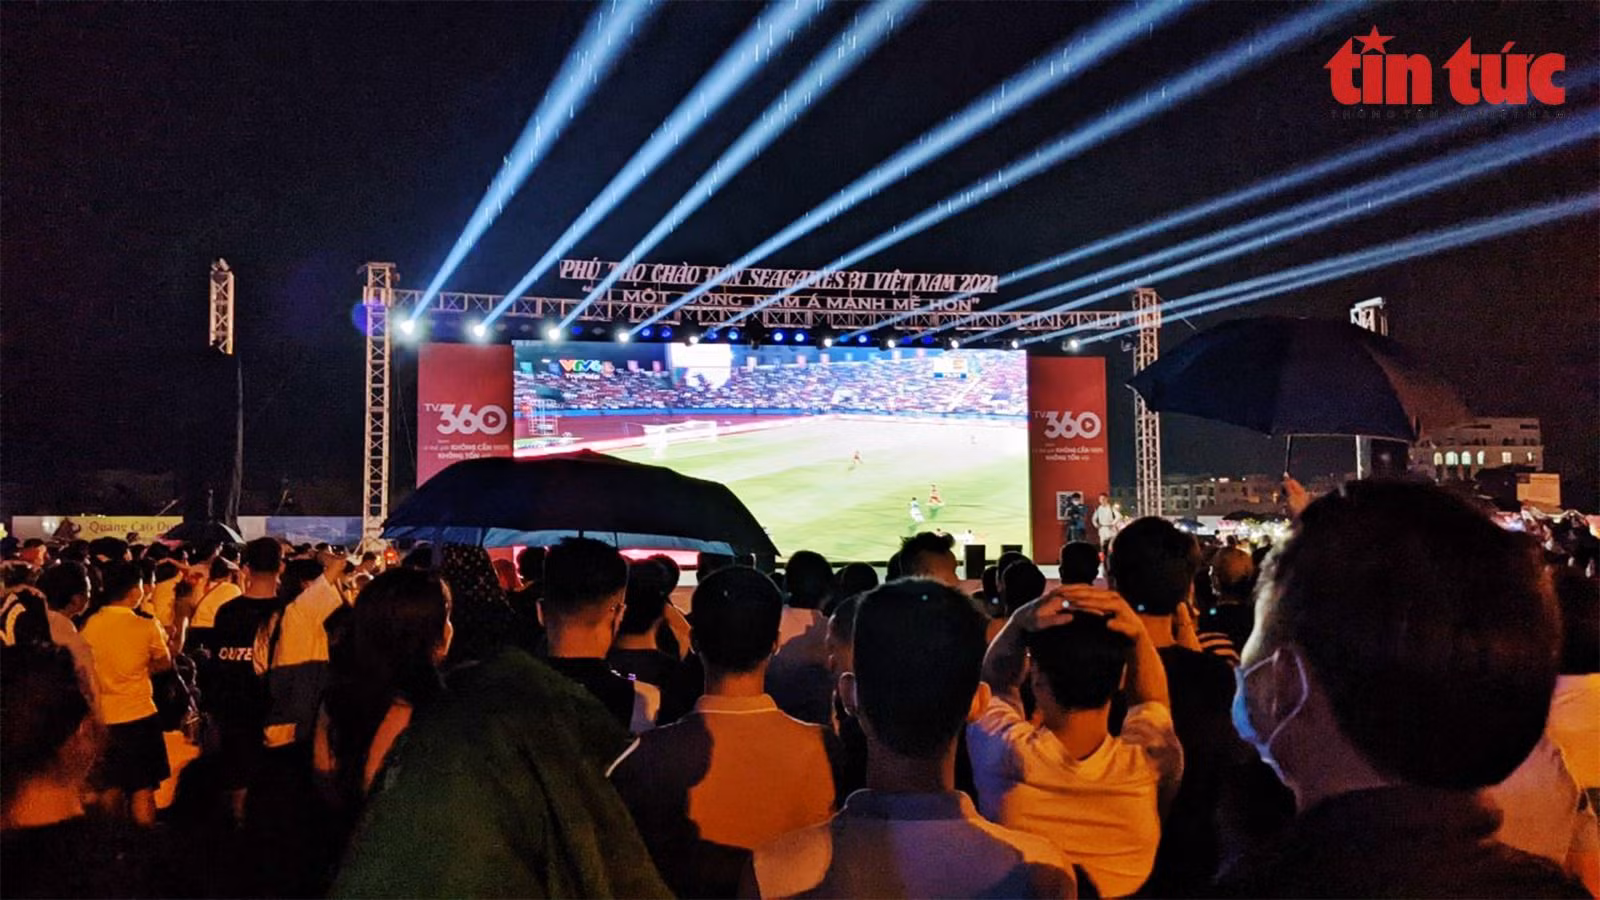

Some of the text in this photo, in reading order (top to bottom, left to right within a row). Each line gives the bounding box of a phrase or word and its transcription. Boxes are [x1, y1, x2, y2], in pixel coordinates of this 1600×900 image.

[560, 257, 600, 280] PHÚ
[651, 262, 700, 285] CHÀO
[848, 271, 868, 291] 31
[874, 269, 914, 295] VIỆT
[916, 273, 955, 293] NAM
[807, 293, 820, 309] Á
[437, 404, 507, 434] 360
[1044, 411, 1102, 439] 360
